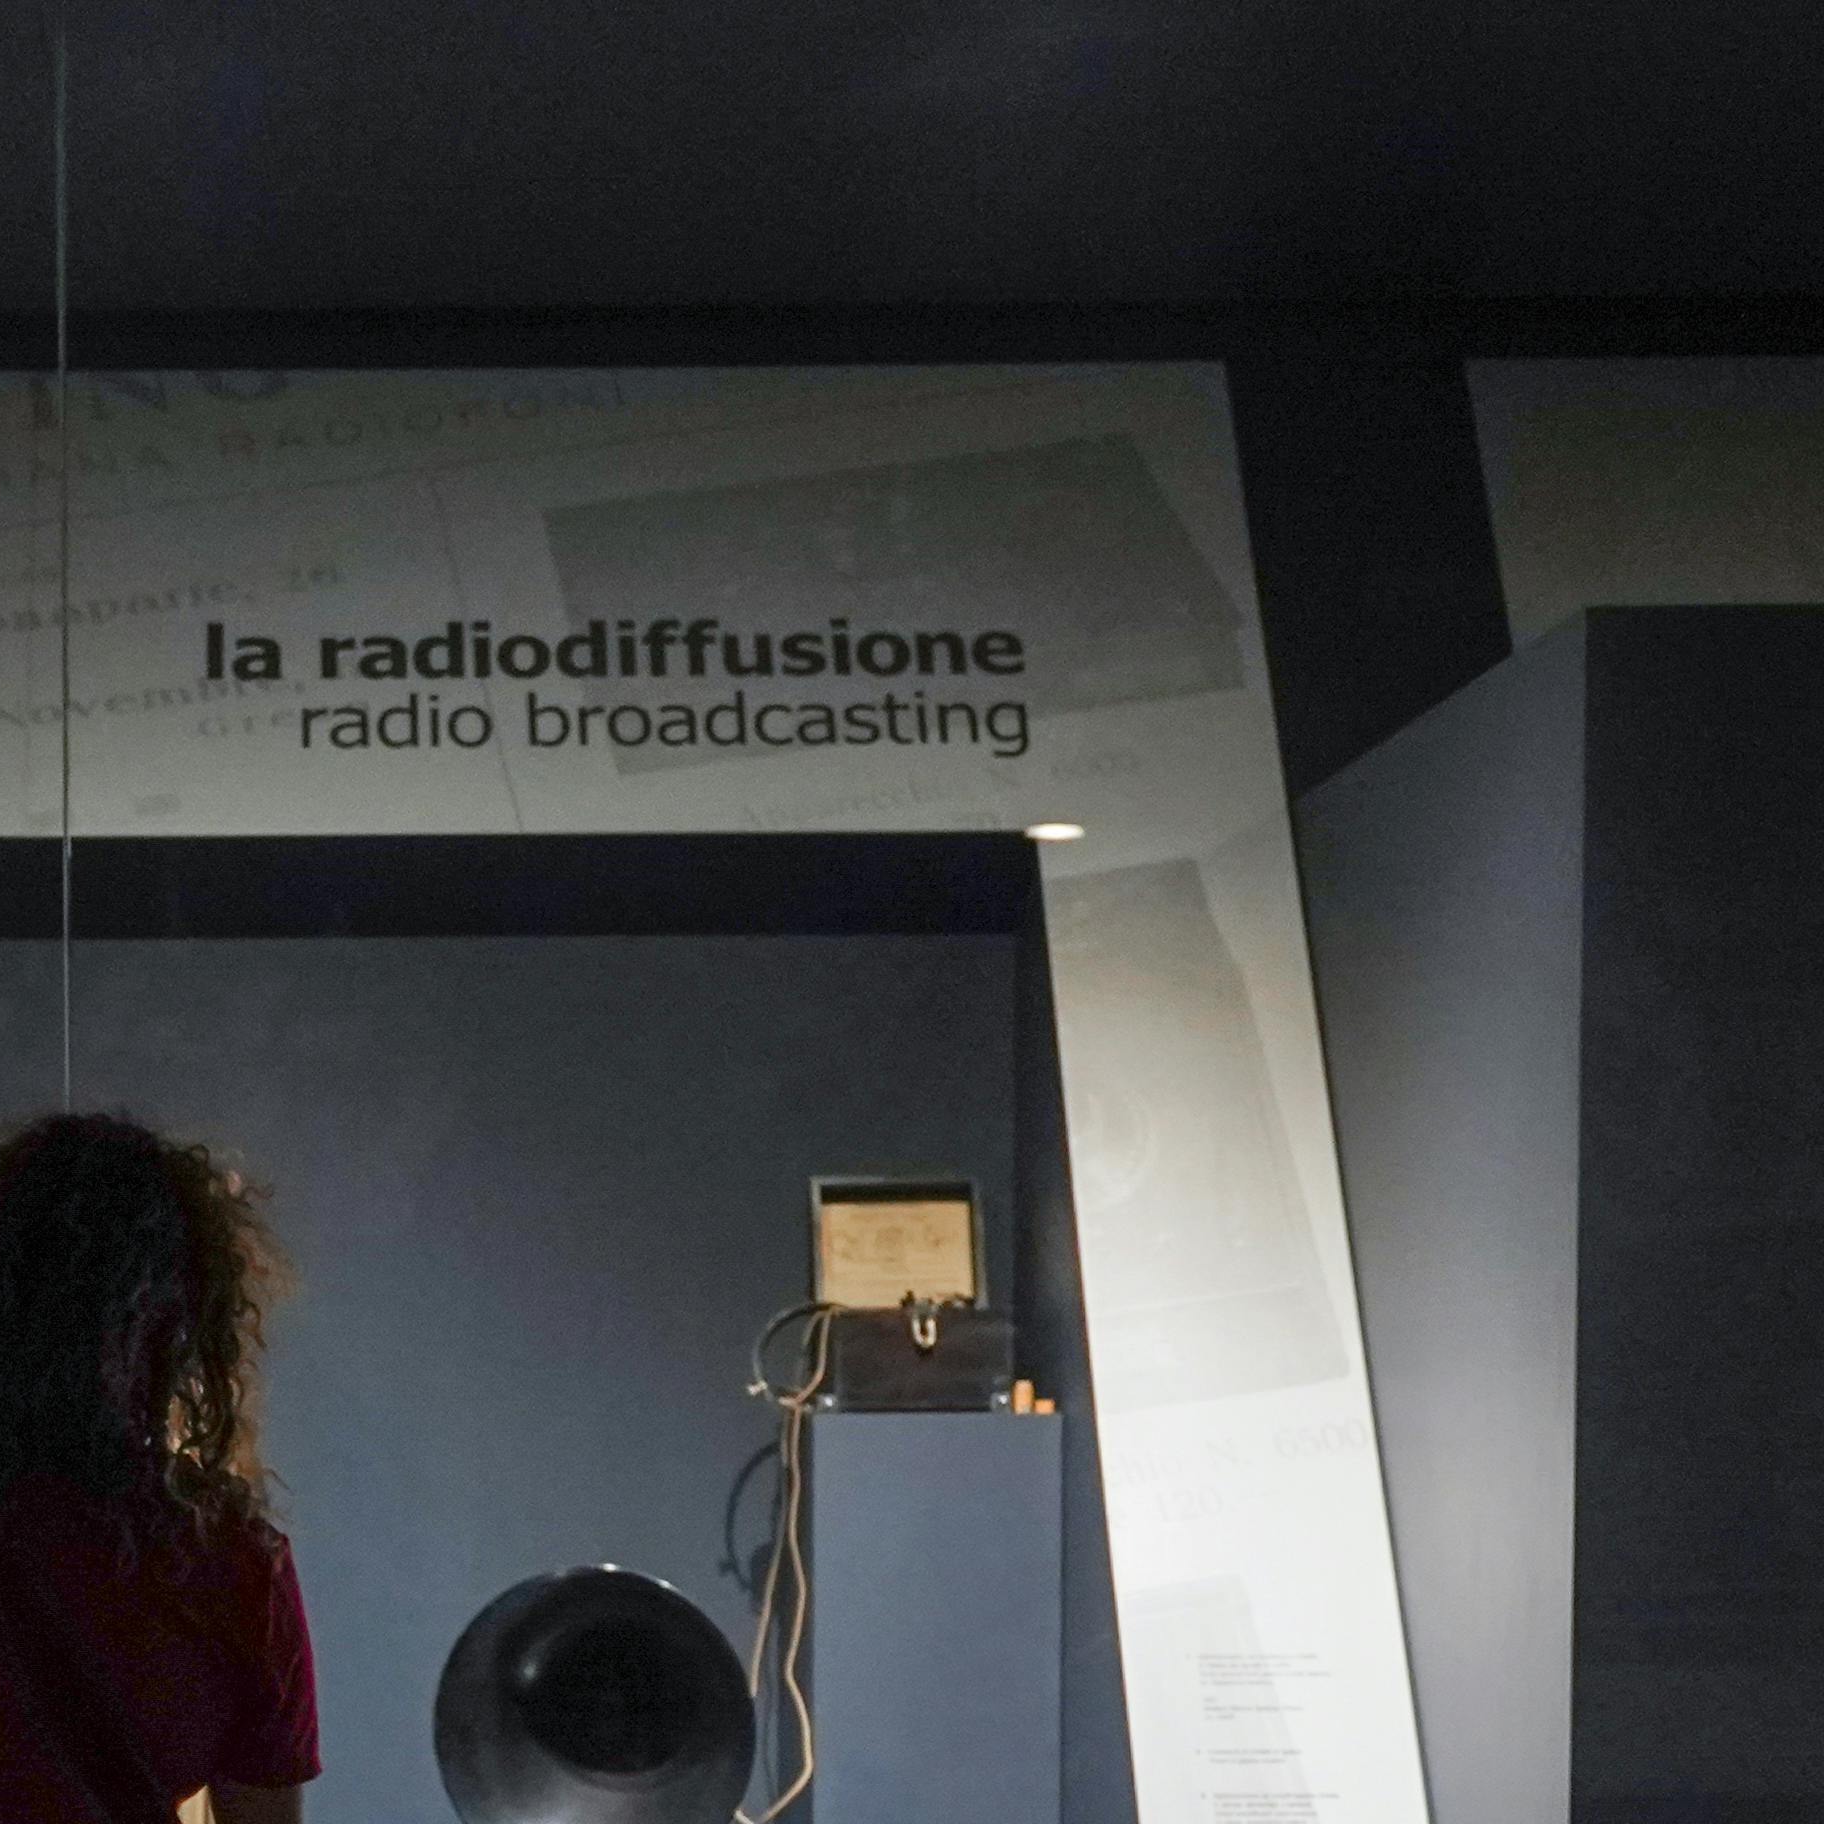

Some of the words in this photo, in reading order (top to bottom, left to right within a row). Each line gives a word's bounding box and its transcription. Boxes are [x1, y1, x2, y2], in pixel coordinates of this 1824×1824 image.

[206, 622, 283, 682] la
[318, 617, 1026, 680] radiodiffusione
[300, 692, 495, 750] radio
[526, 690, 1031, 759] broadcasting
